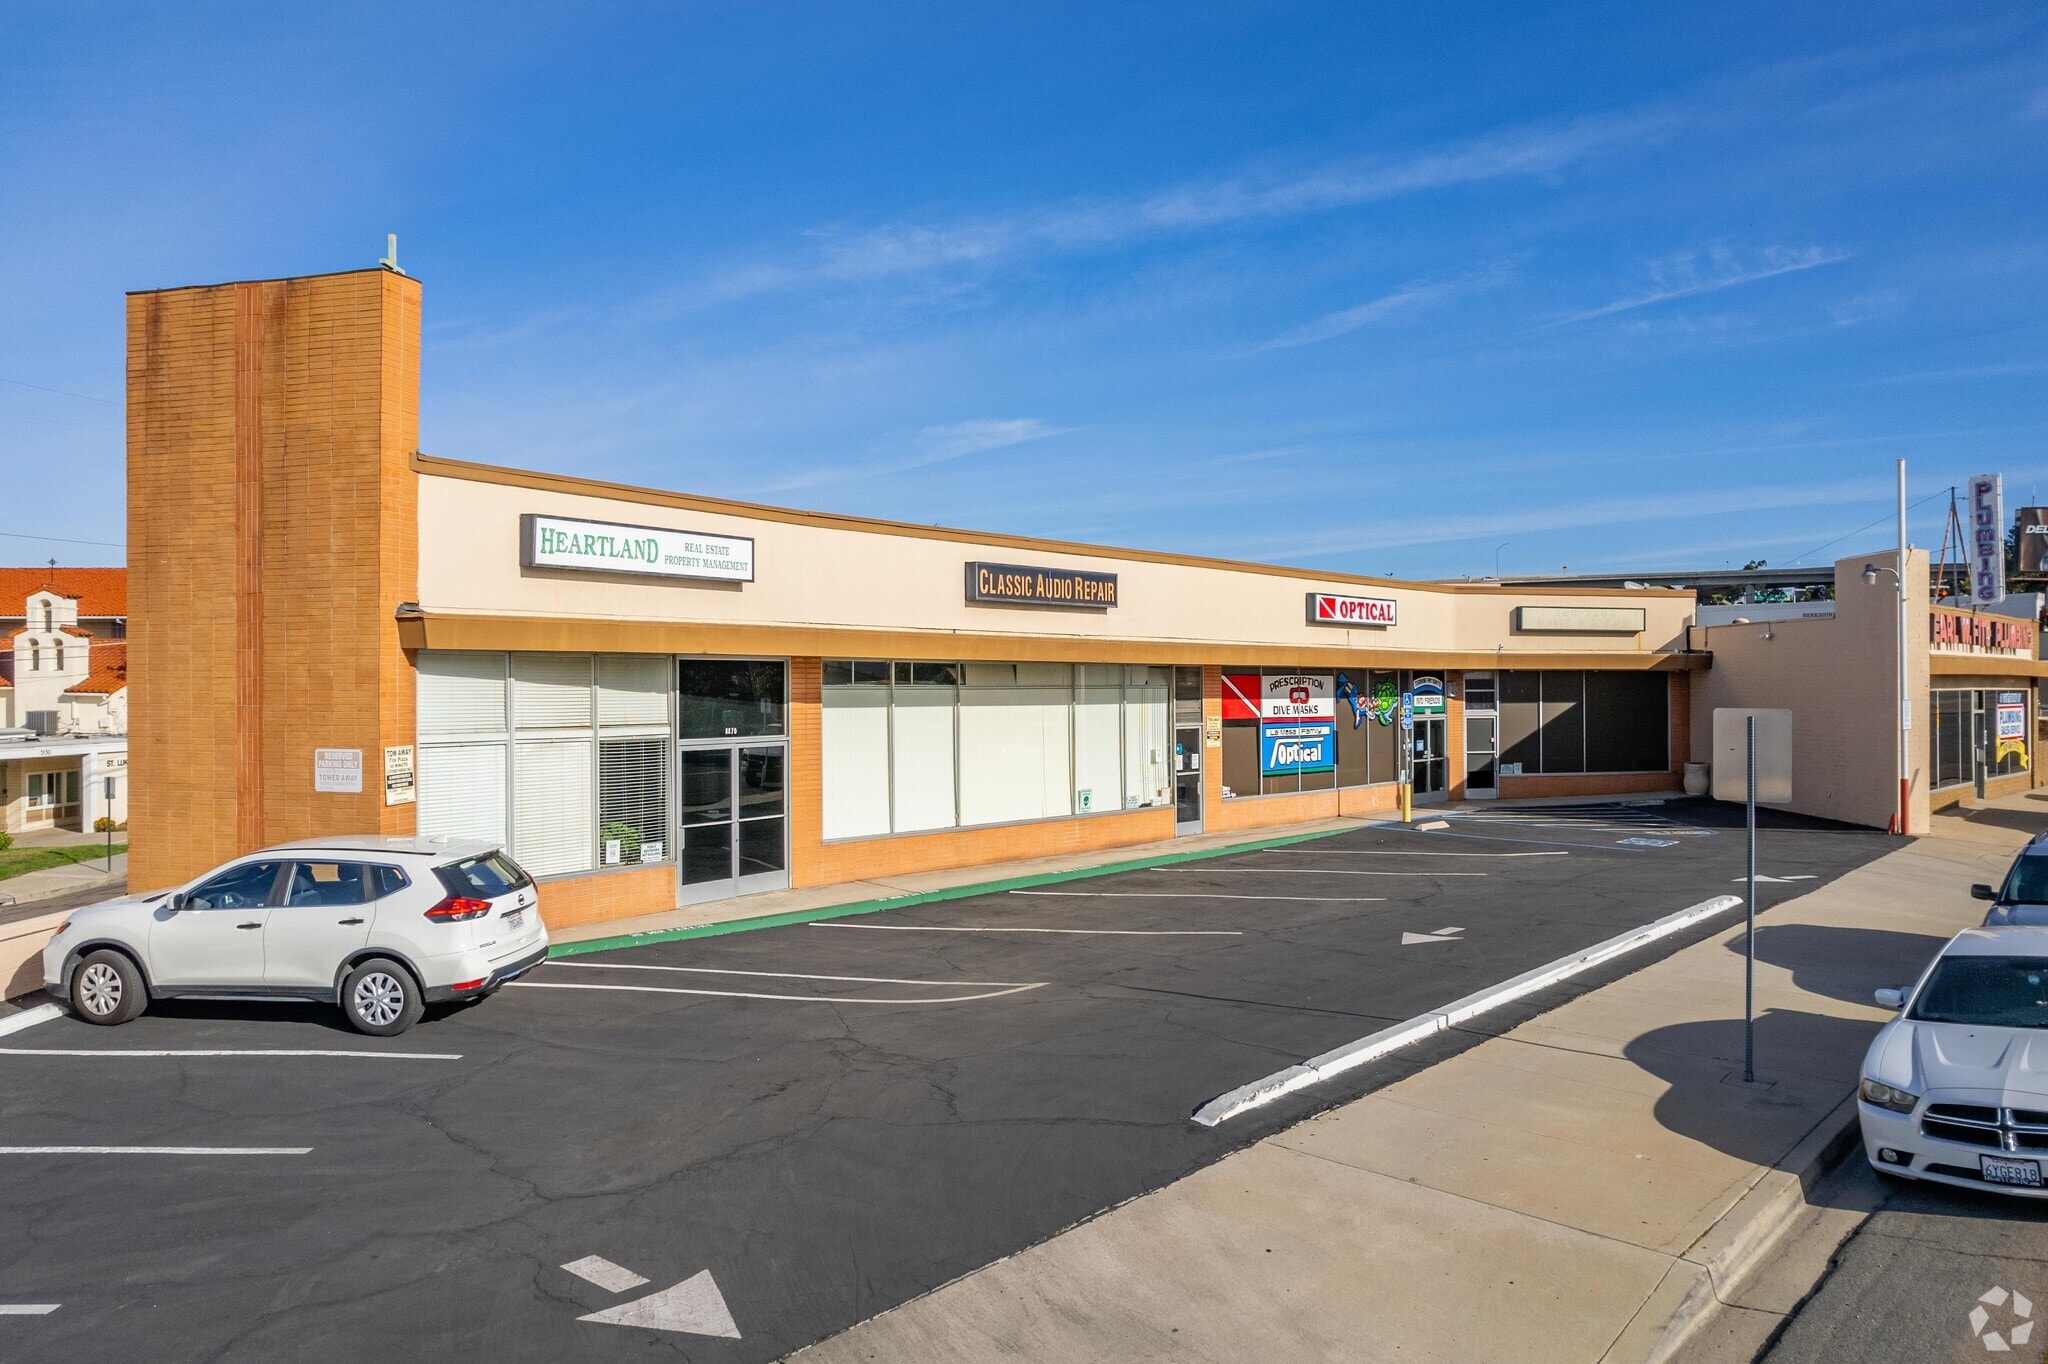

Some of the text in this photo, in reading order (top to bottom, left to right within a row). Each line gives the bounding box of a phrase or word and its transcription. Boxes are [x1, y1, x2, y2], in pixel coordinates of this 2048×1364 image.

[540, 527, 659, 563] HEARTLAND
[684, 542, 730, 556] REAL ESTATE
[1975, 482, 1995, 600] PLUMBING
[664, 555, 749, 572] PROPERTY MANAGEMENT
[979, 568, 1115, 602] CLASSIC AUDIO REPAIR
[1340, 600, 1394, 621] OPTICAL
[1269, 676, 1325, 693] PRESCRIPTION
[1273, 704, 1319, 715] DIVE MASKS
[1278, 743, 1322, 765] Optical
[318, 760, 359, 769] PARKING ONLY
[340, 774, 358, 782] AWAY
[1985, 1164, 2038, 1181] 6YGE818
